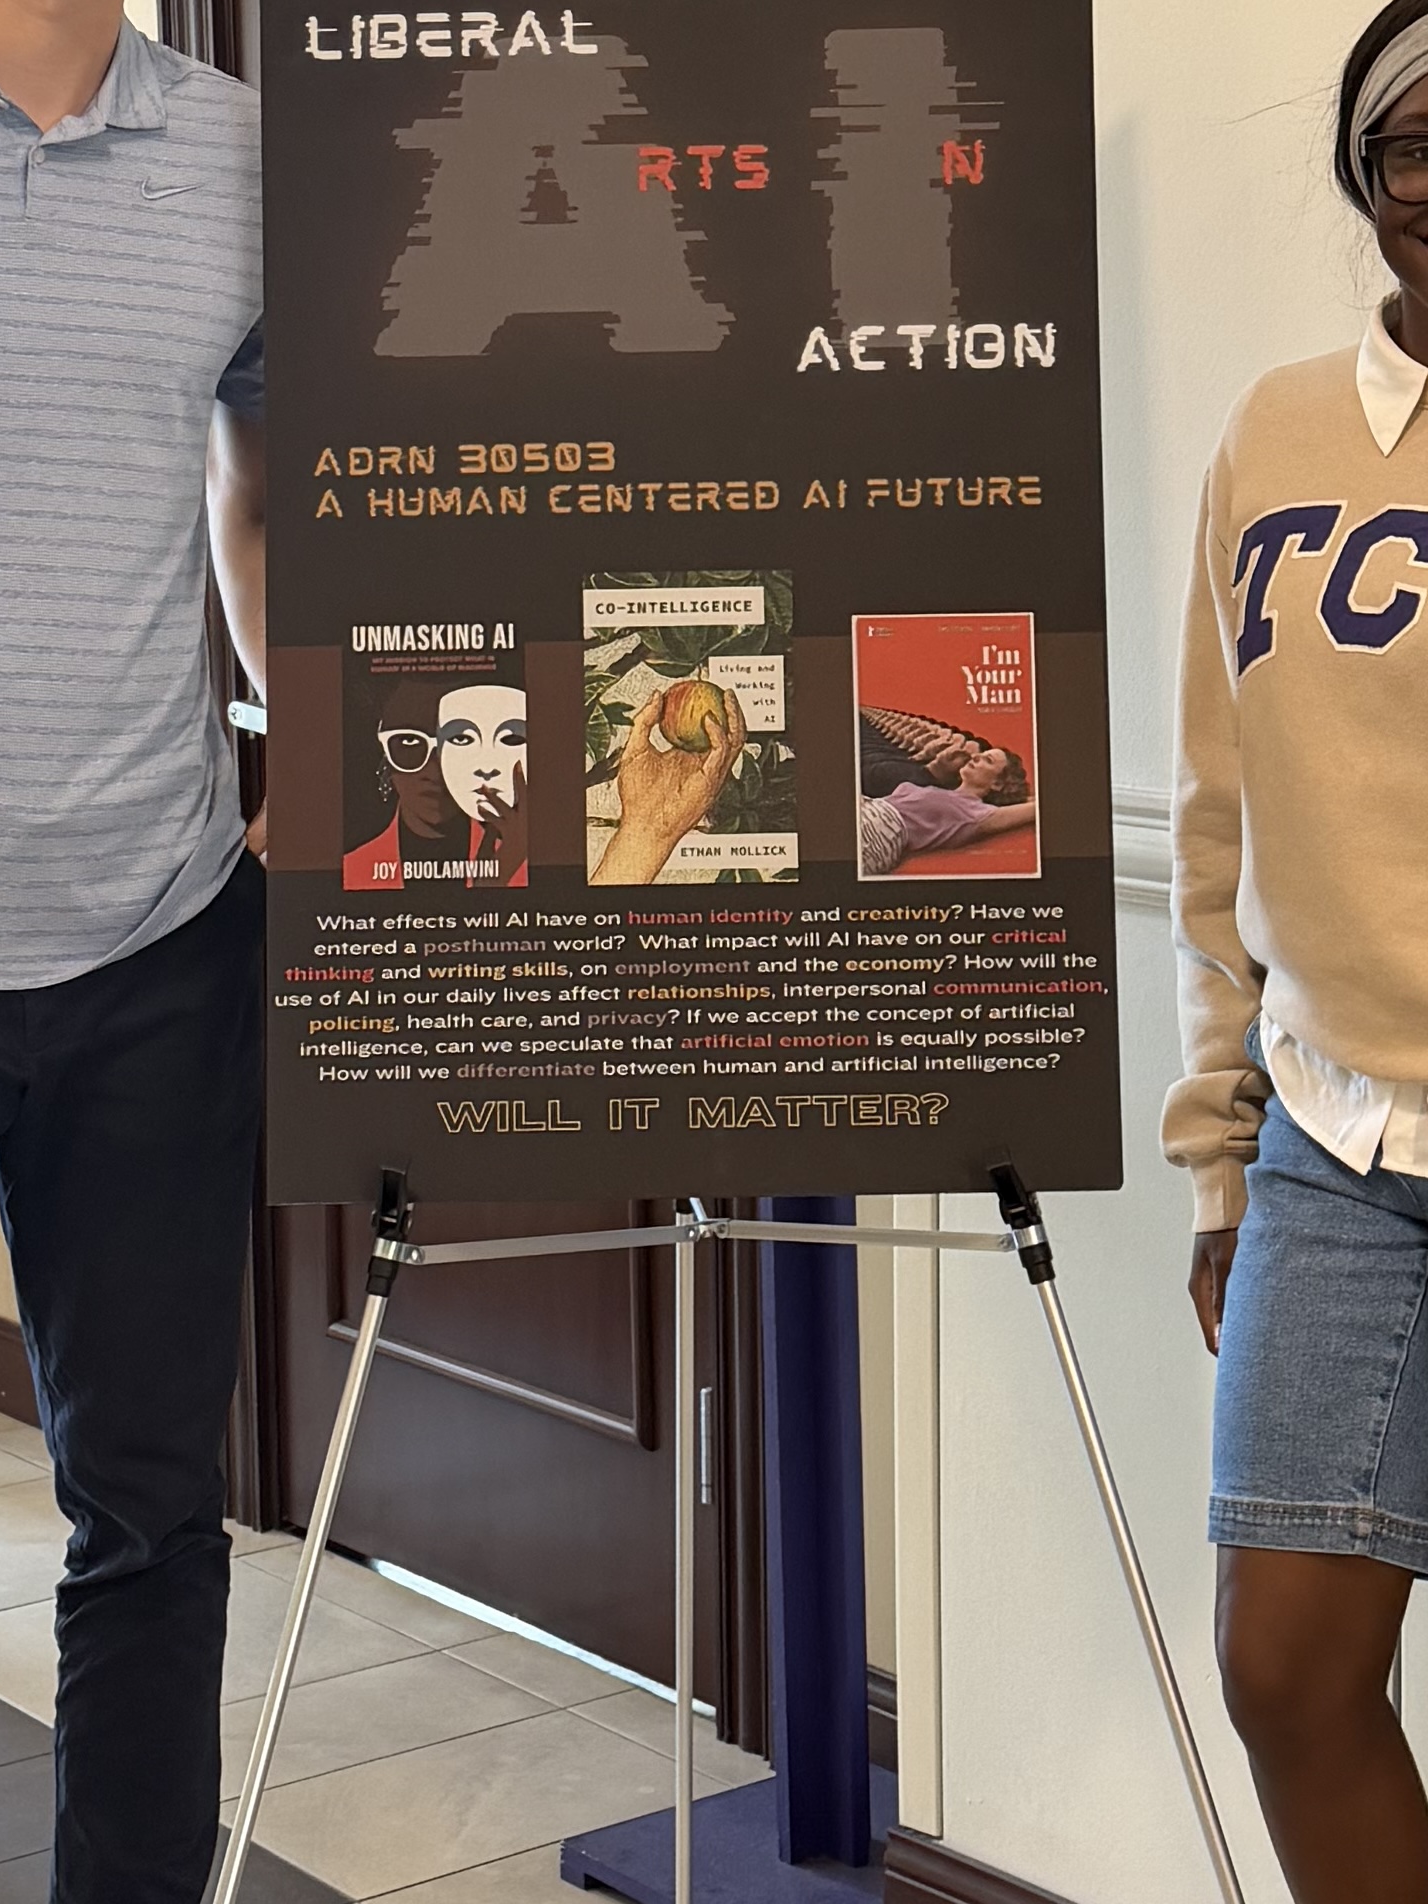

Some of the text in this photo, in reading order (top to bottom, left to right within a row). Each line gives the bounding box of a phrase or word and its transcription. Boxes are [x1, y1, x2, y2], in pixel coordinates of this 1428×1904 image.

[305, 9, 598, 60] LIBERAL
[797, 323, 1057, 373] ACTION
[458, 442, 615, 473] 30503
[316, 476, 1042, 518] A HUMAN CENTERED AI FUTURE
[595, 600, 753, 615] CO-INTELLIGENCE
[352, 623, 514, 652] UNMASKING AI
[720, 664, 775, 674] Living and
[961, 665, 1022, 684] Your
[735, 681, 775, 691] Working
[966, 685, 1022, 705] Man
[753, 698, 776, 706] with
[763, 715, 776, 723] AI
[681, 841, 786, 857] ETHAN MOLLICK
[372, 860, 499, 880] JOY BUOLAMWINI
[316, 904, 1064, 931] What effects will AI have on human identity and creativity? Have we
[314, 928, 1067, 957] entered a posthuman world? What impact will AI have on our critical
[284, 953, 1097, 983] thinking and writing skills, on employment and the economy? How will the
[275, 978, 1108, 1007] use of AI in our daily lives affect relationships, interpersonal communication,
[309, 1002, 1075, 1035] policing, health care, and privacy? If we accept the concept of artificial
[300, 1027, 1086, 1058] intelligence, can we speculate that artificial emotion is equally possible?
[319, 1053, 1061, 1081] How will we differentiate between human and artificial intelligence?
[437, 1092, 949, 1133] WILL IT MATTER?
